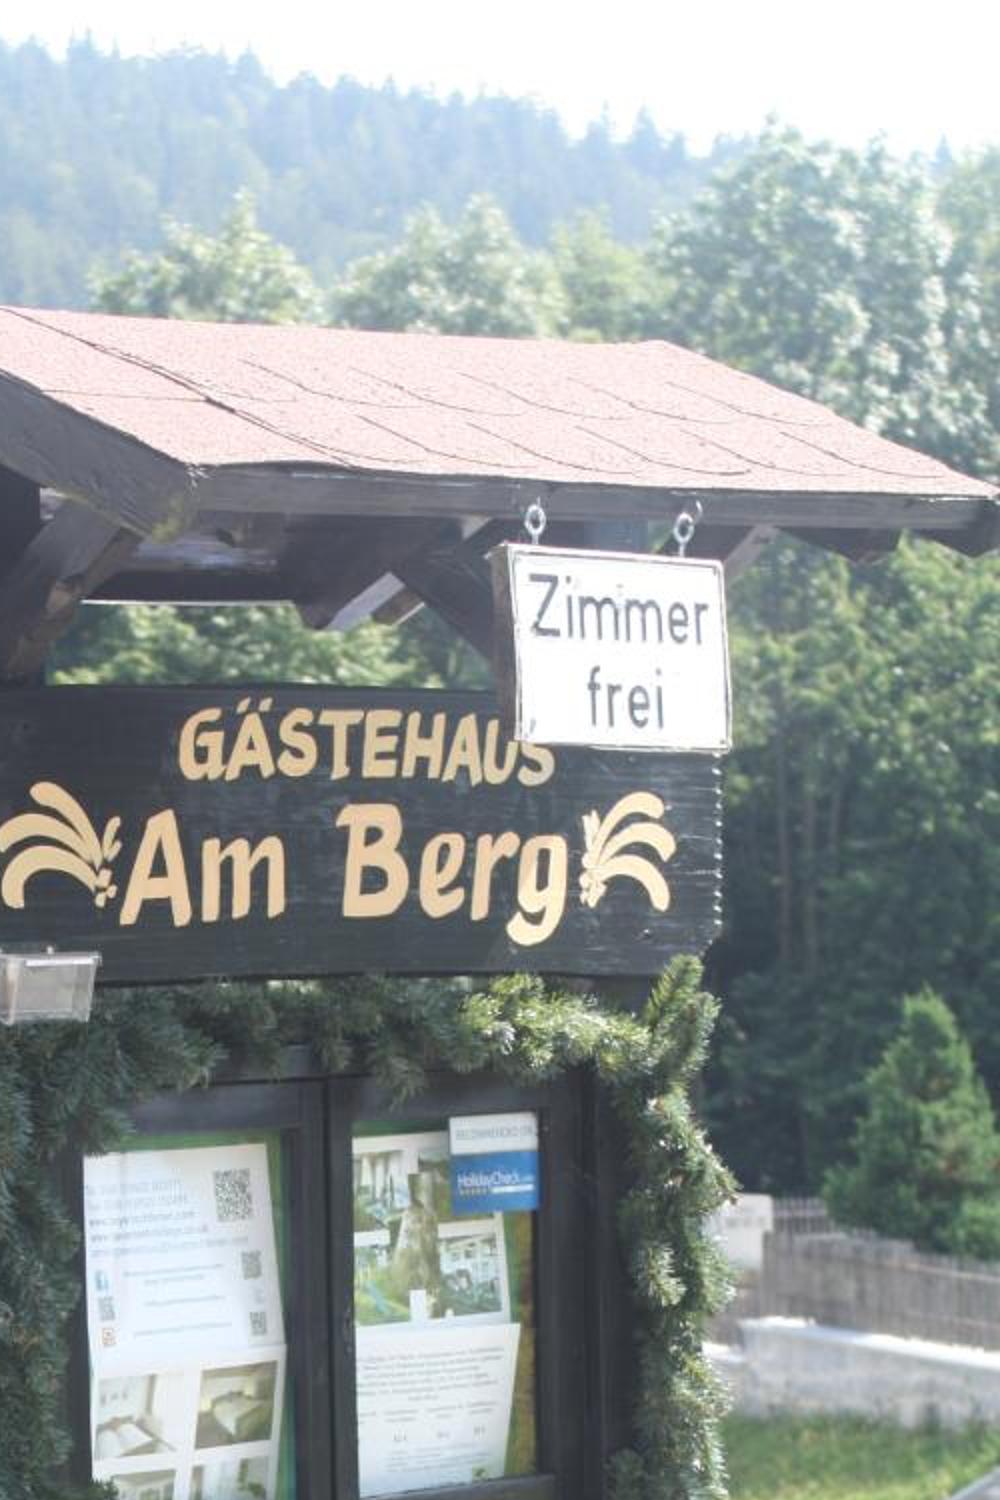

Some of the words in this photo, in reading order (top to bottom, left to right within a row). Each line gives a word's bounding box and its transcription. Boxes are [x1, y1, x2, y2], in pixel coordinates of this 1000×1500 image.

[528, 572, 709, 645] Zimmer
[587, 665, 664, 729] frei
[178, 697, 556, 788] GÄSTEHAUS
[119, 808, 286, 928] Am
[335, 803, 568, 947] Berg
